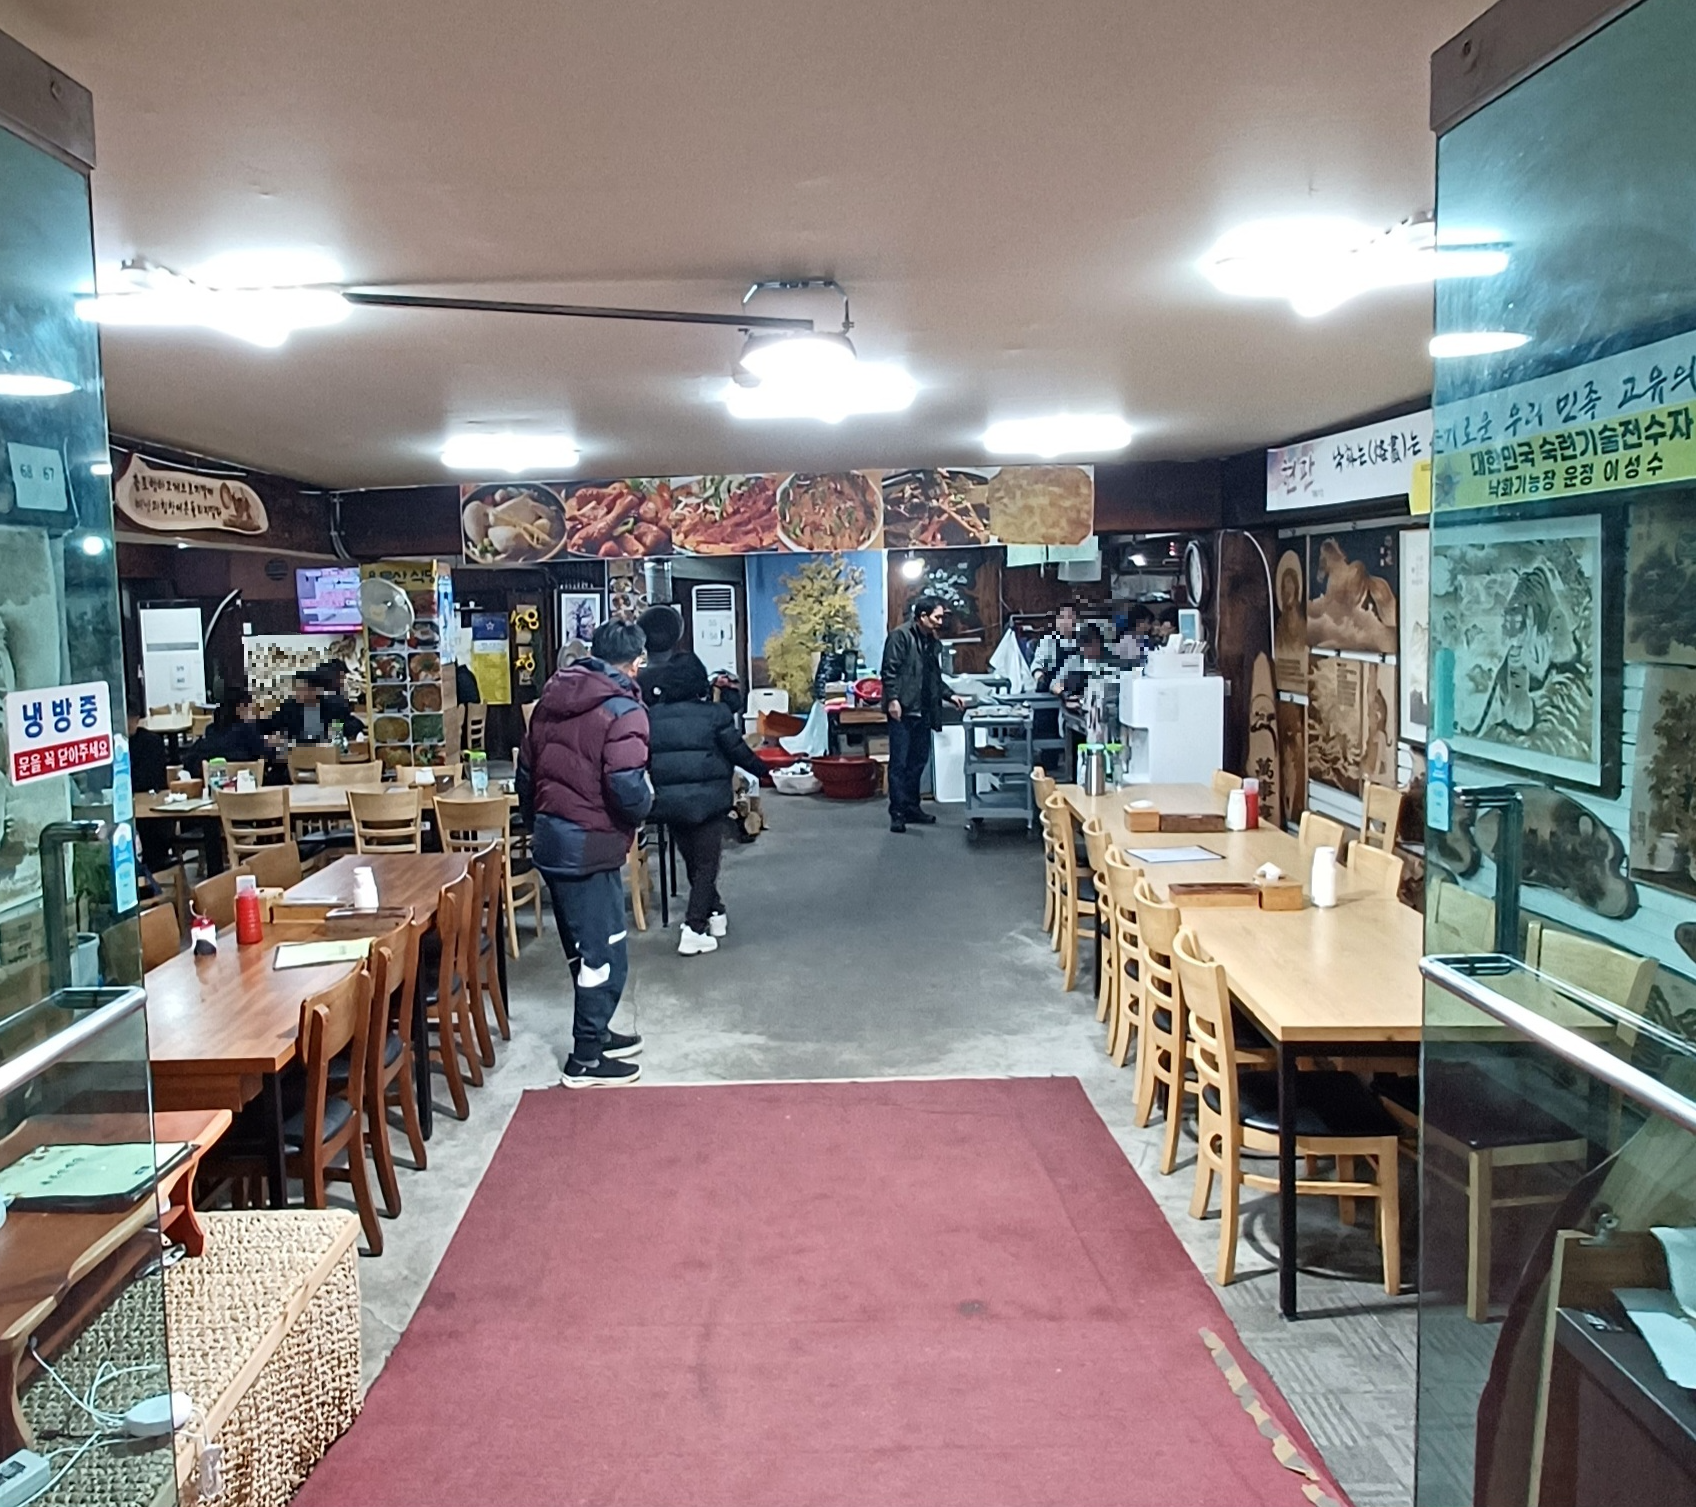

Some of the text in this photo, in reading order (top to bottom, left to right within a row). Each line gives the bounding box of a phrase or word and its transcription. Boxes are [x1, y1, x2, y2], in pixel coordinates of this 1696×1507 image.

[1504, 402, 1543, 437] 우리
[1556, 380, 1601, 424] 민족
[1470, 407, 1694, 477] 대한민국 숙련기술전수자
[42, 466, 55, 482] 67
[1488, 468, 1557, 498] 낙화기능장
[1563, 463, 1594, 489] 운정
[18, 753, 42, 777] 문을
[44, 750, 56, 770] 꼭
